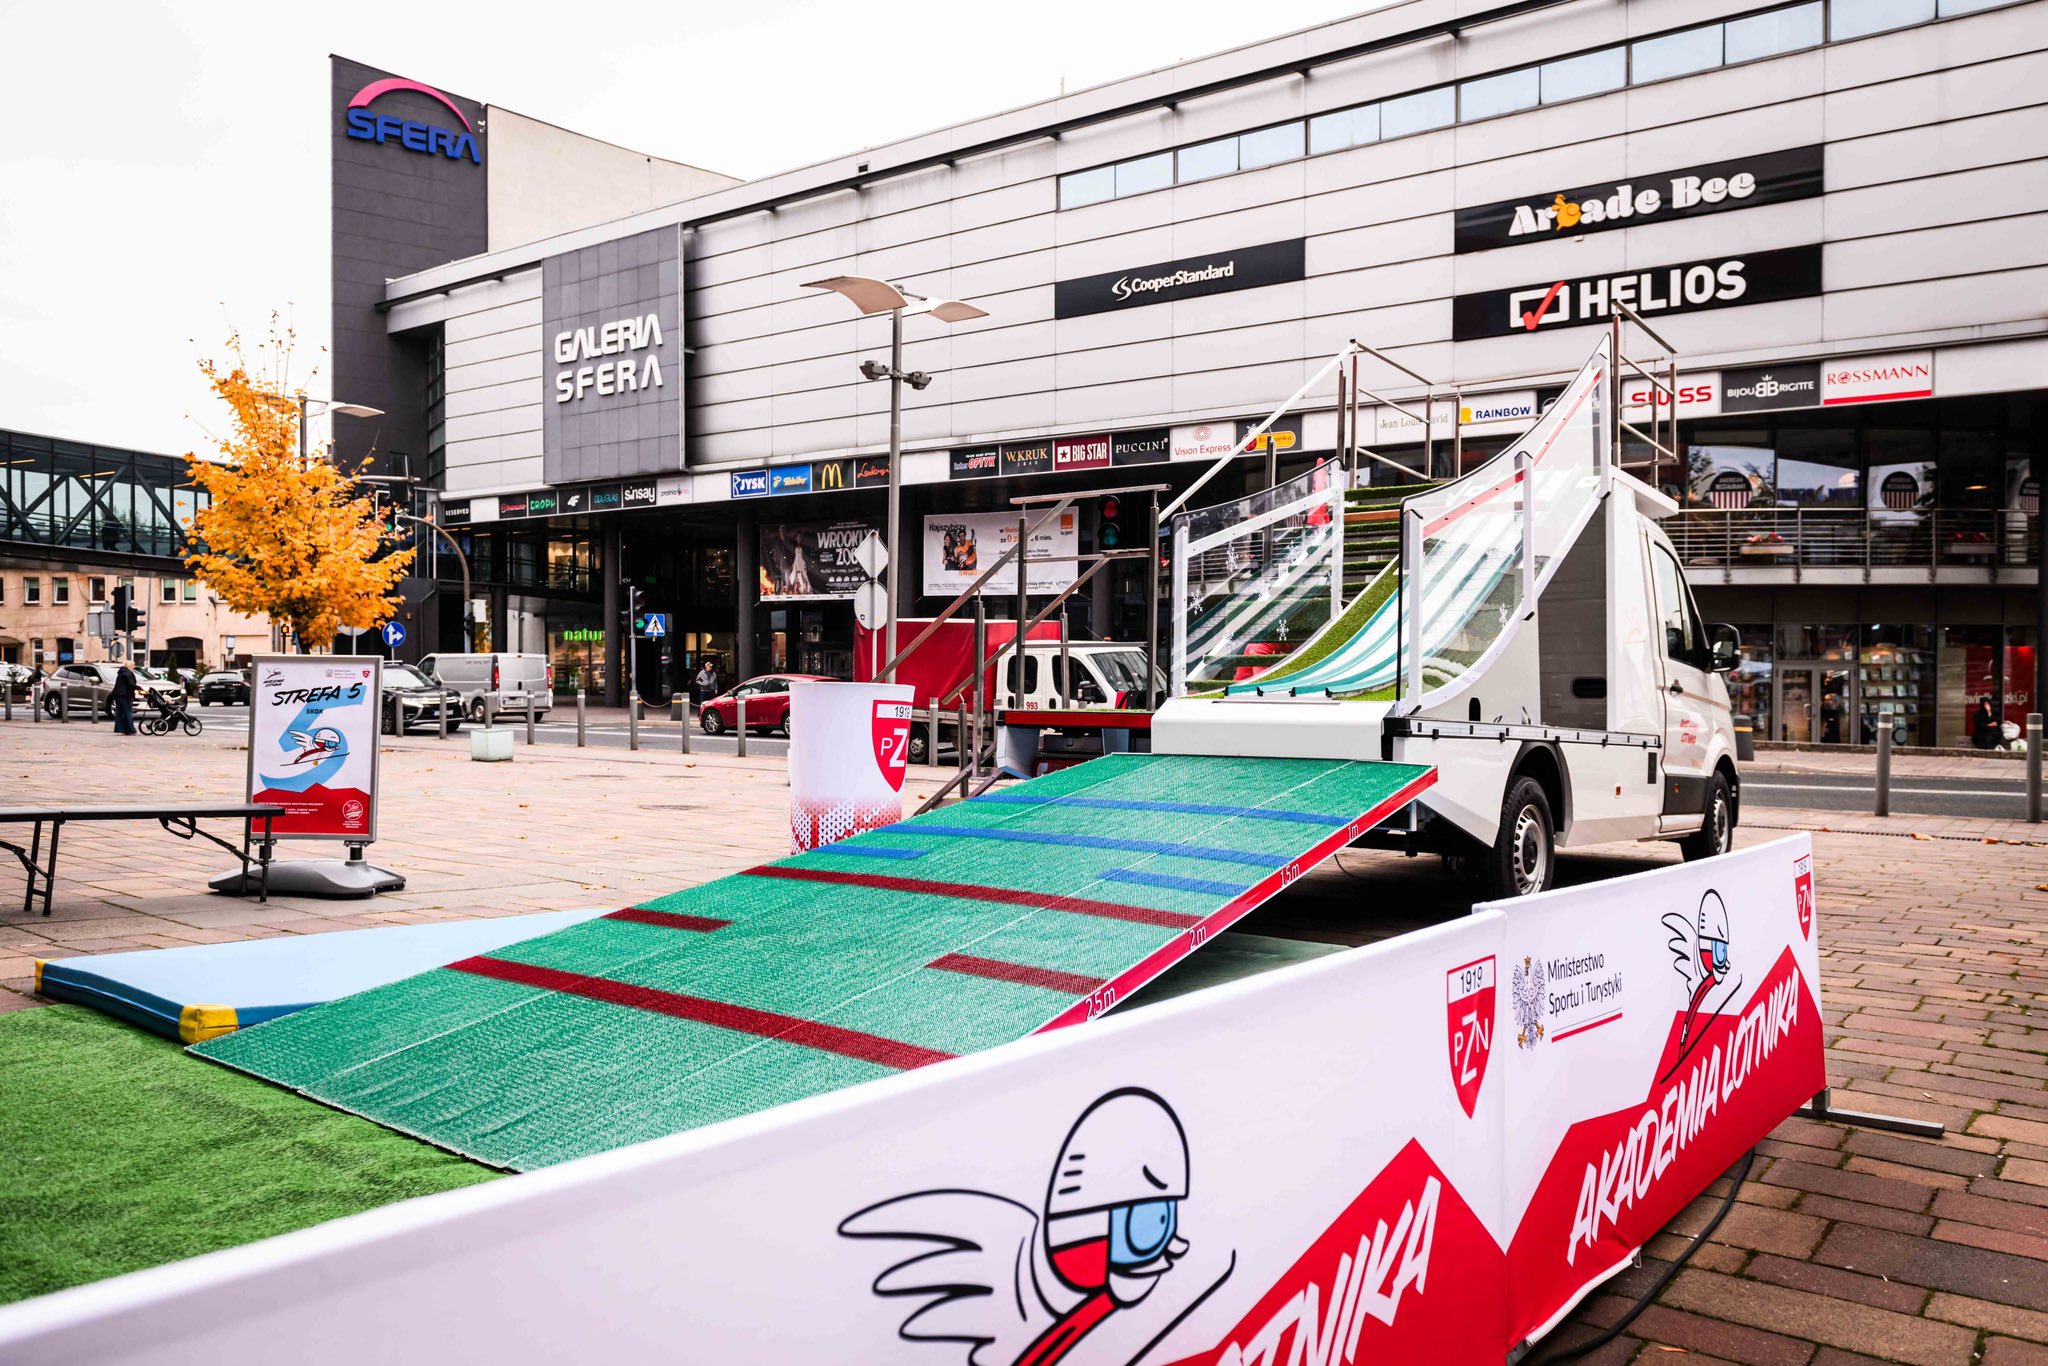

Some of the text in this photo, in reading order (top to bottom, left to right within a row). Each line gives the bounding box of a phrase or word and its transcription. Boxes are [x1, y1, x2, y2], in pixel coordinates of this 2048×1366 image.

[347, 107, 481, 164] SFERA
[1671, 172, 1756, 210] Bee
[1131, 261, 1234, 293] CooperStandard
[1579, 260, 1747, 319] HELIOS
[554, 313, 664, 364] GALERIA
[555, 354, 664, 403] SFERA
[1827, 364, 1929, 385] ROSSMANN
[1631, 385, 1712, 409] SWSS
[1727, 386, 1756, 398] BIJOU
[1380, 419, 1399, 429] Jean
[1475, 406, 1531, 419] RAINBOW
[1072, 442, 1107, 462] BIG STAR
[1174, 443, 1231, 456] Vision Express
[624, 486, 655, 502] sinsay
[740, 477, 766, 491] JYSK
[530, 499, 555, 510] CROPP
[817, 529, 880, 549] WROOKL
[563, 628, 605, 641] natur
[271, 682, 363, 706] STREFA 5
[1026, 702, 1038, 710] 993
[880, 728, 909, 768] PZ
[1348, 823, 1359, 840] 1m
[1189, 925, 1207, 951] 2m
[1547, 952, 1605, 982] Ministerstwo
[1460, 965, 1483, 995] 1919
[1549, 985, 1579, 1018] Sportu
[1585, 972, 1623, 1004] Turystyki
[1453, 1009, 1489, 1087] PZN
[1566, 965, 1800, 1267] AKADEMIA LOTNIKA
